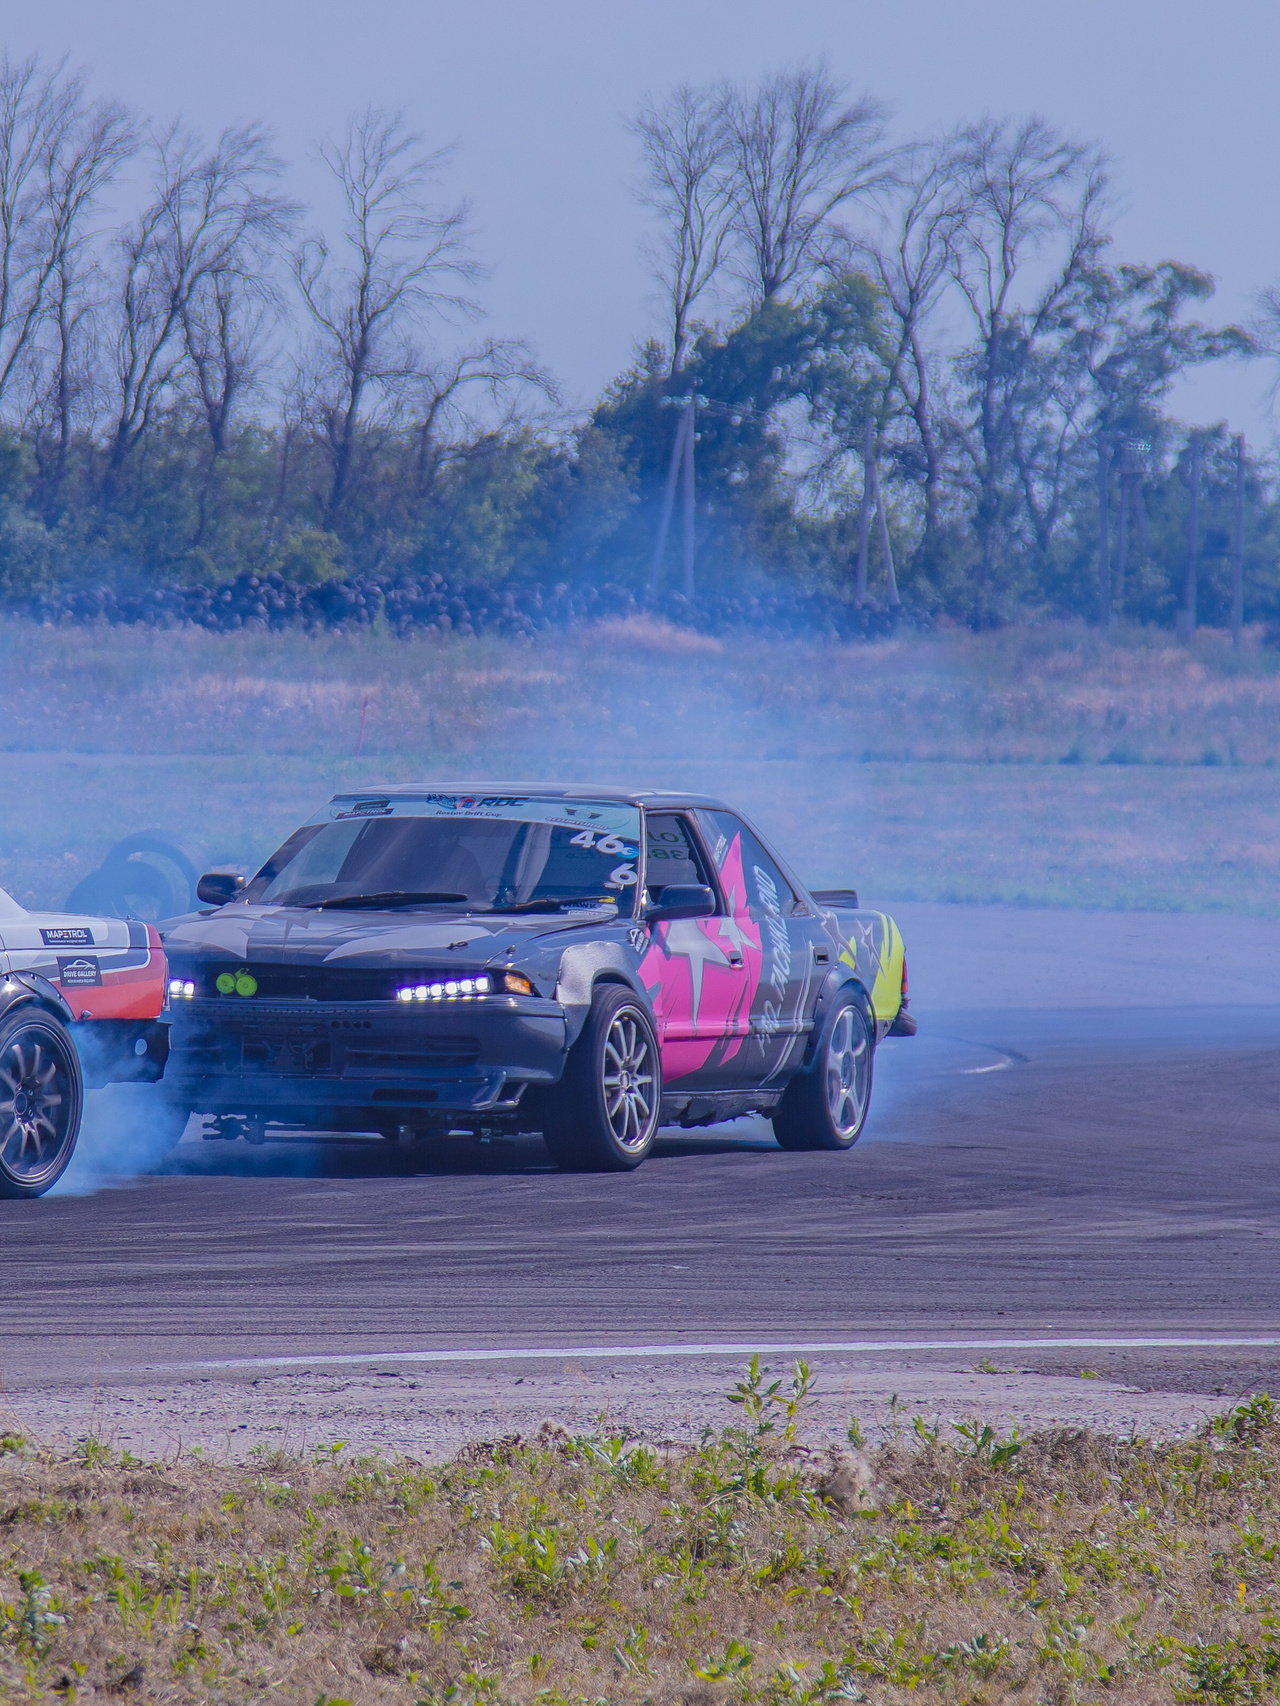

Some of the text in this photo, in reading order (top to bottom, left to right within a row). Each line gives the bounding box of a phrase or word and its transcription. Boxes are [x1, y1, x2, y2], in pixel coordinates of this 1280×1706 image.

[476, 797, 530, 807] RDC
[570, 830, 625, 855] 46
[610, 862, 638, 885] 6
[46, 929, 88, 939] MAPETROL
[63, 970, 97, 978] DRIVE GALLERY
